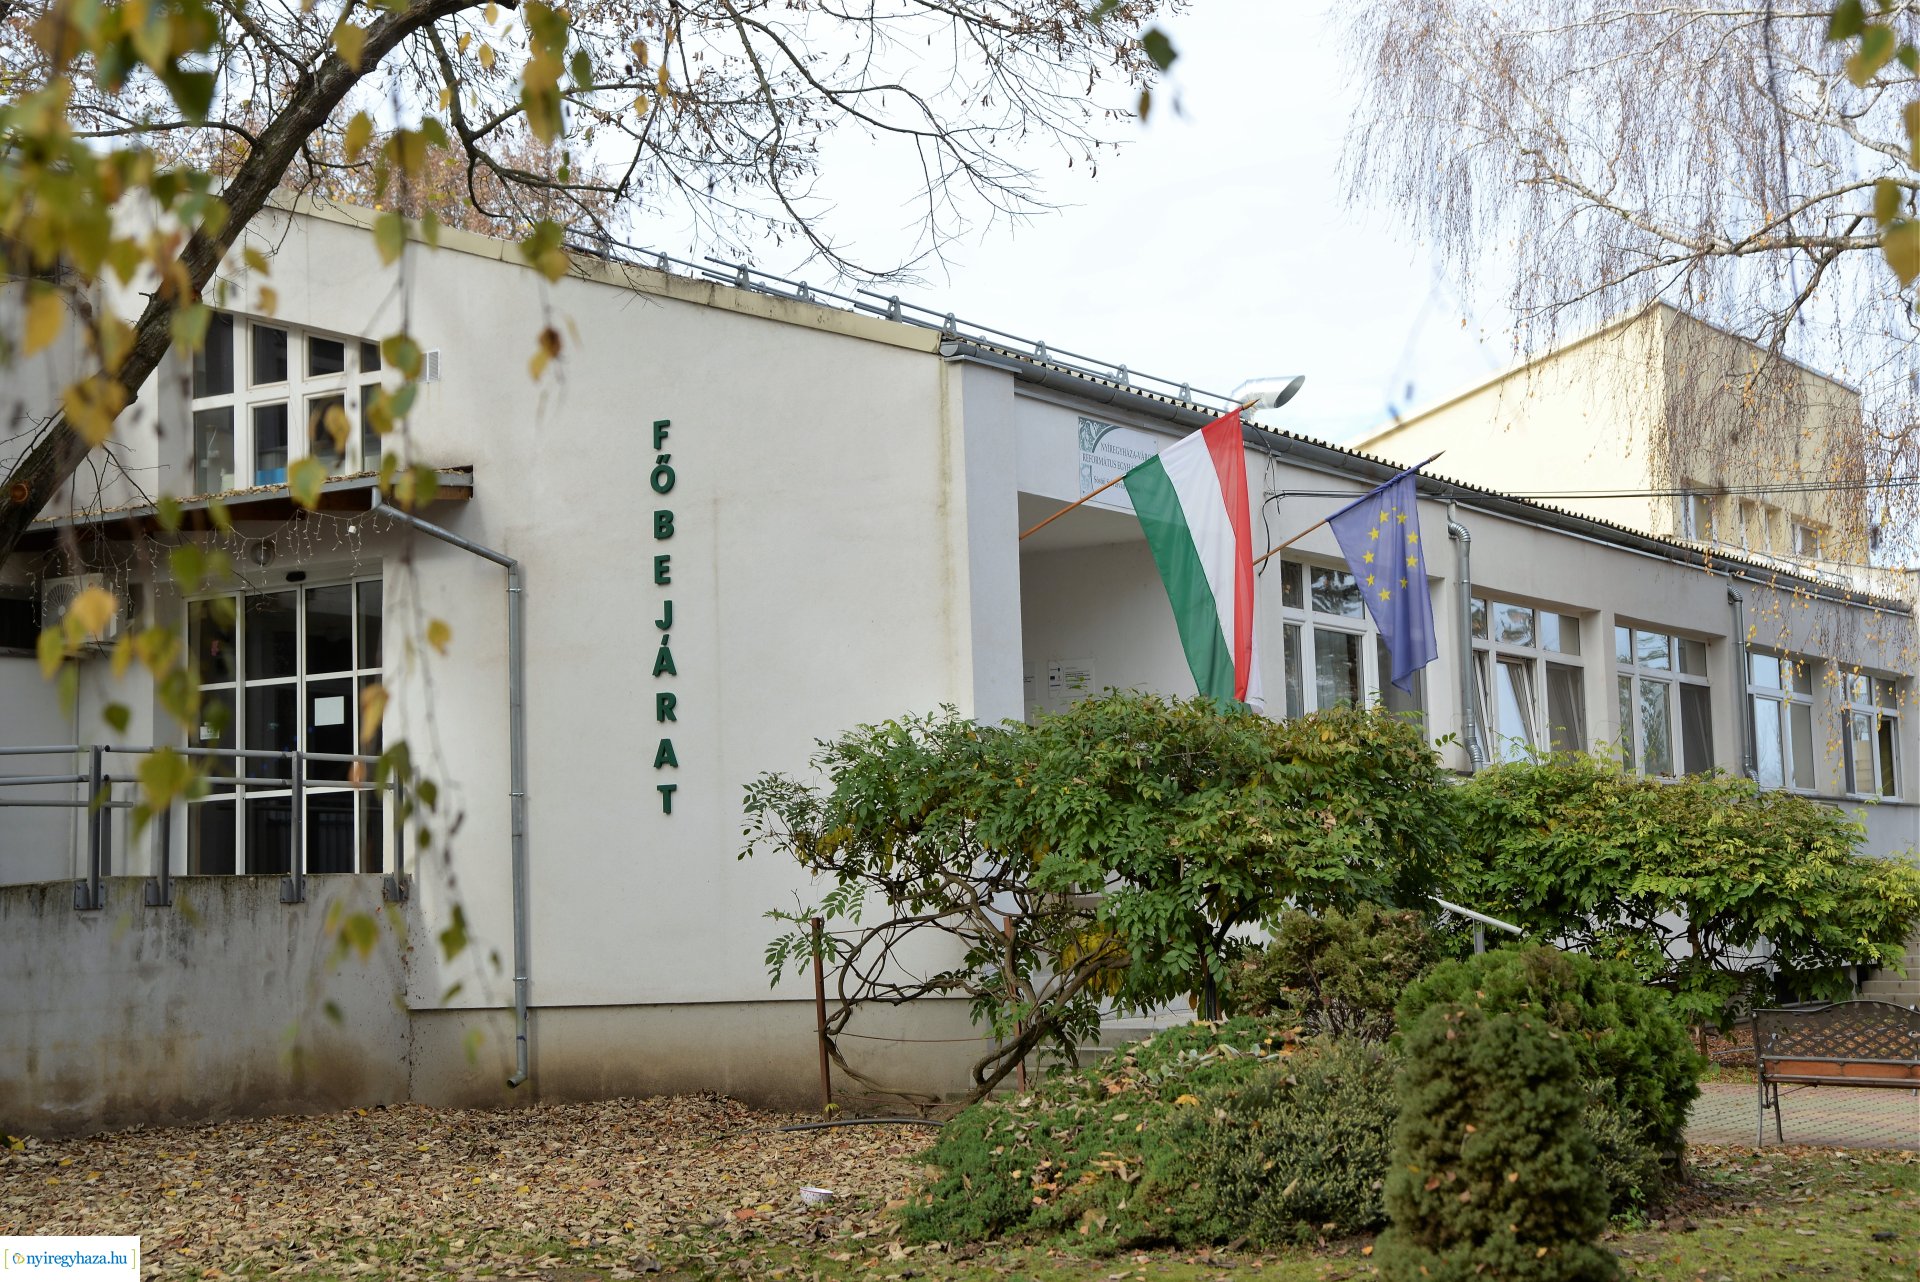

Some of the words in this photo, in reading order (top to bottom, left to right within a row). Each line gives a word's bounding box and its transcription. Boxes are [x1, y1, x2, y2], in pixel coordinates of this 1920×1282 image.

[1082, 453, 1117, 469] REFORMÁTUS
[1100, 442, 1154, 461] NYÍREGYHÁZA-VÁRO
[650, 419, 679, 815] FŐBEJÁRAT
